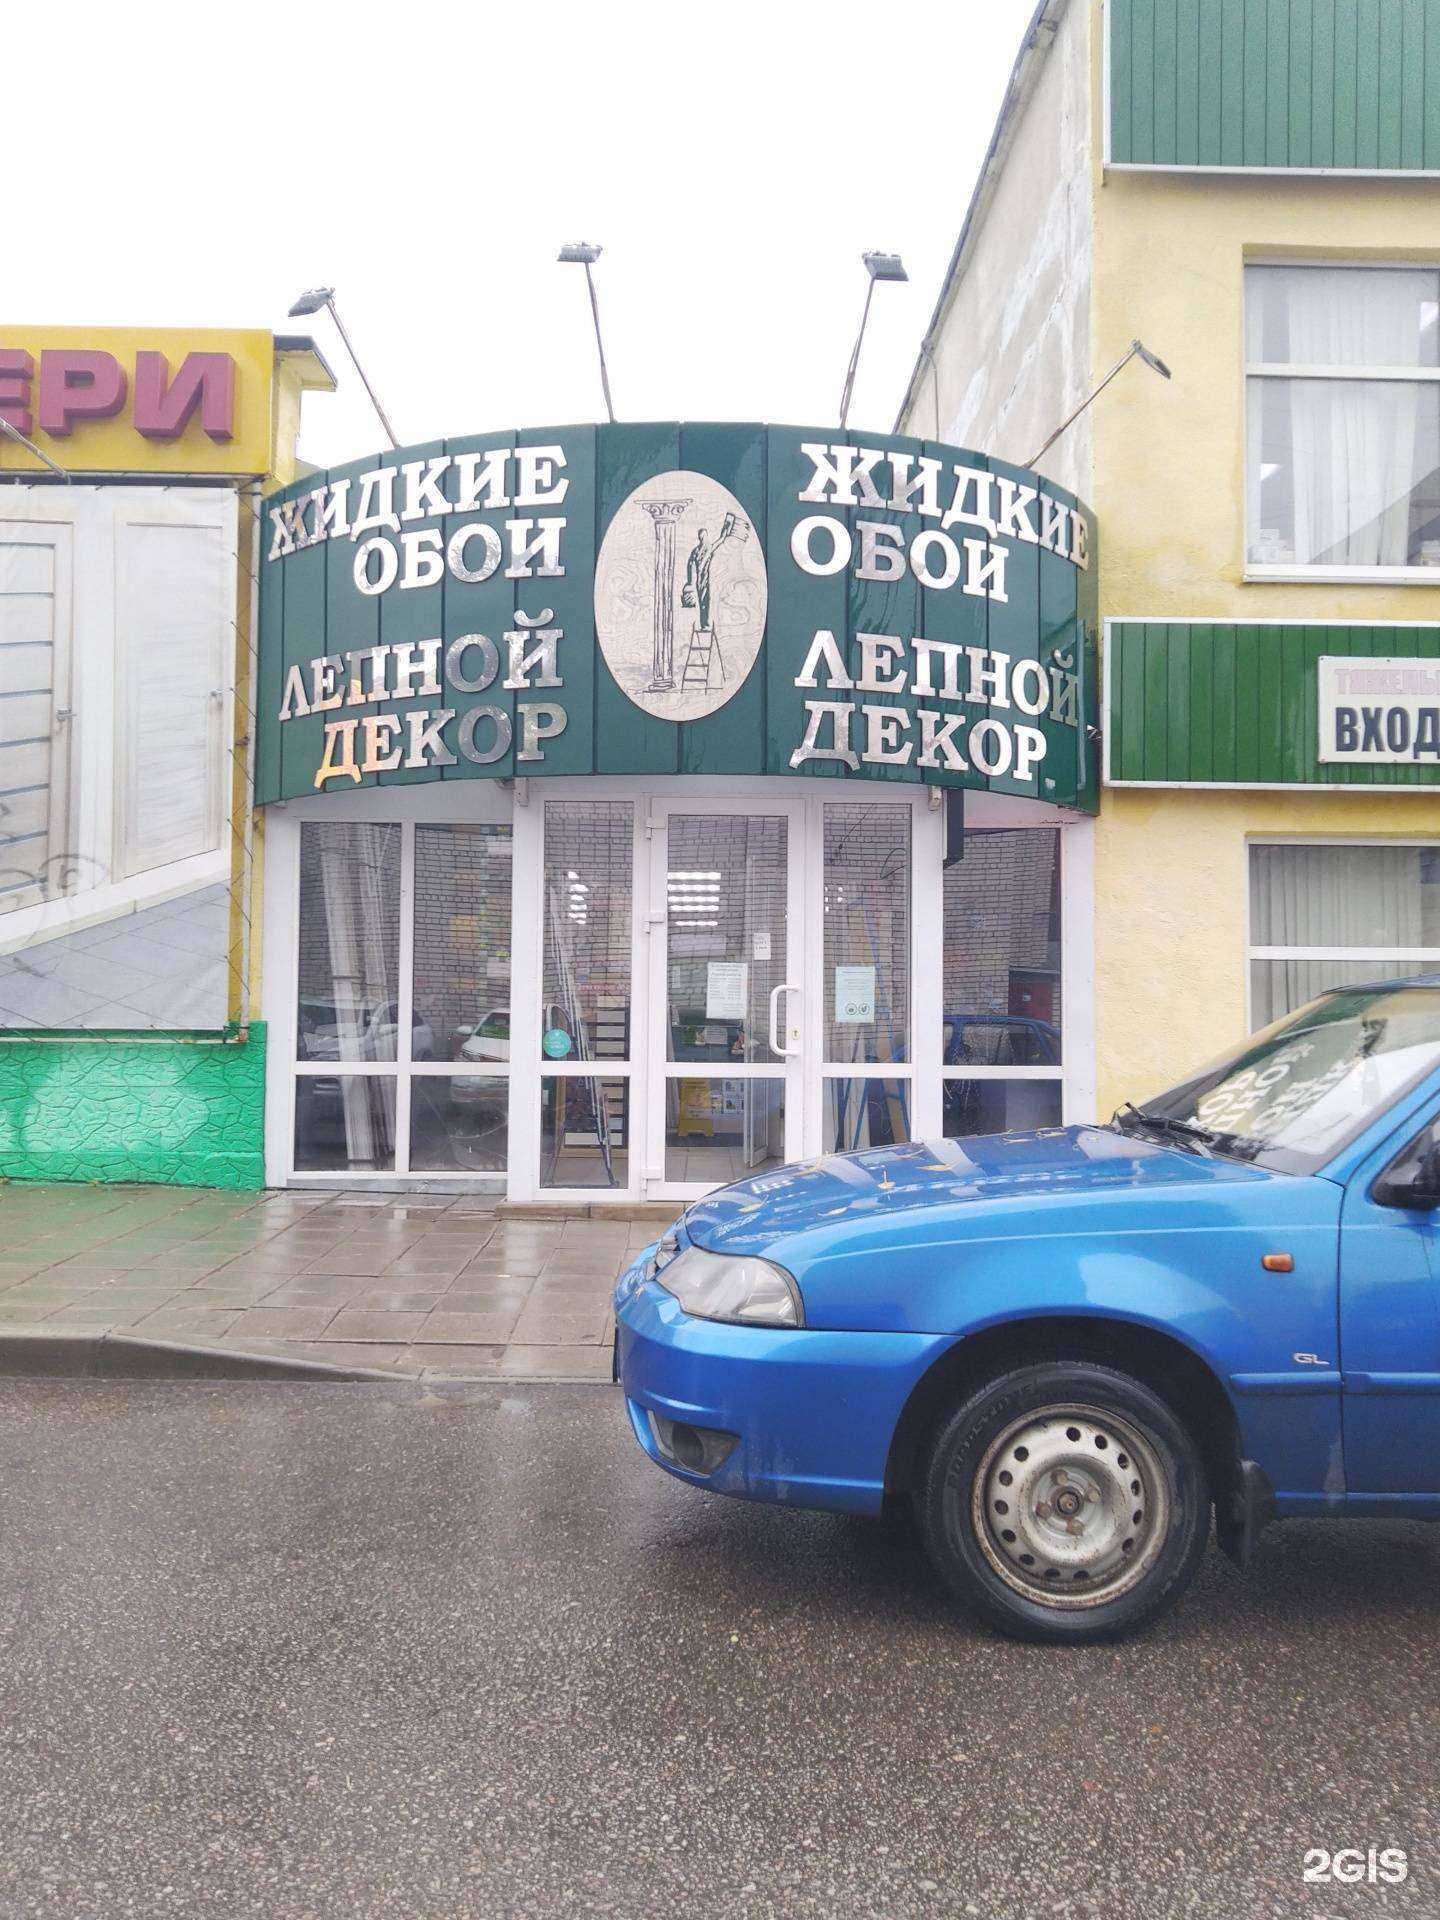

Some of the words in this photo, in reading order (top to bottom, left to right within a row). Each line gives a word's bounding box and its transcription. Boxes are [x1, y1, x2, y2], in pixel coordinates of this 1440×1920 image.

[268, 445, 570, 562] ЖИДКИЕ
[799, 443, 1089, 572] ЖИДКИЕ
[353, 517, 567, 596] ОБОИ
[790, 515, 1009, 603] ОБОИ
[278, 608, 564, 721] ЛЕПНОЙ
[794, 629, 1079, 727] ЛЕПНОЙ
[314, 703, 568, 789] ДЕКОР
[789, 700, 1047, 781] ДЕКОР
[1335, 706, 1440, 760] ВХОД
[1293, 1352, 1331, 1366] GL
